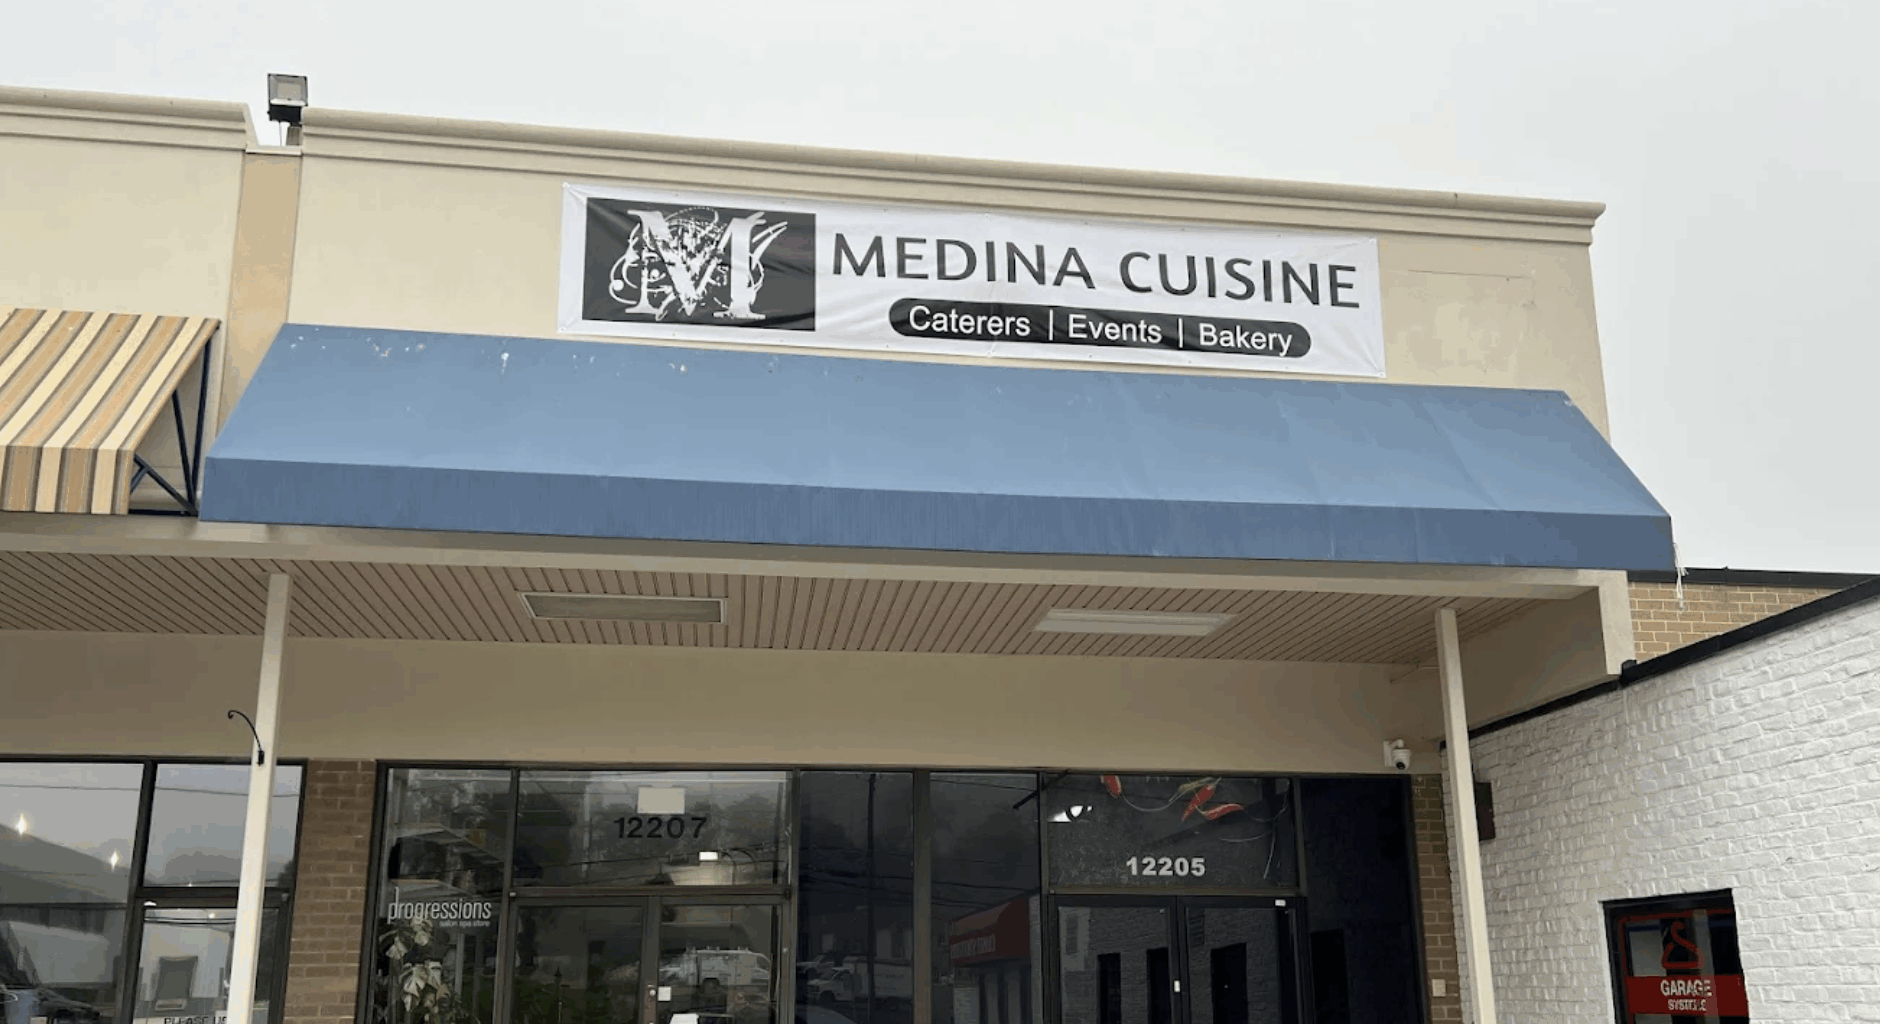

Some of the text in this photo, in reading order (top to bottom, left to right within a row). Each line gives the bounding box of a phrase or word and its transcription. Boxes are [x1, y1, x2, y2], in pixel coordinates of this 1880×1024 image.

[832, 232, 1360, 308] MEDINA CUISINE
[908, 304, 1293, 357] Caterers Events Bakery
[615, 817, 707, 839] 12207
[1126, 856, 1206, 877] 12205
[387, 886, 492, 924] progressions
[1660, 979, 1713, 997] GARAGE
